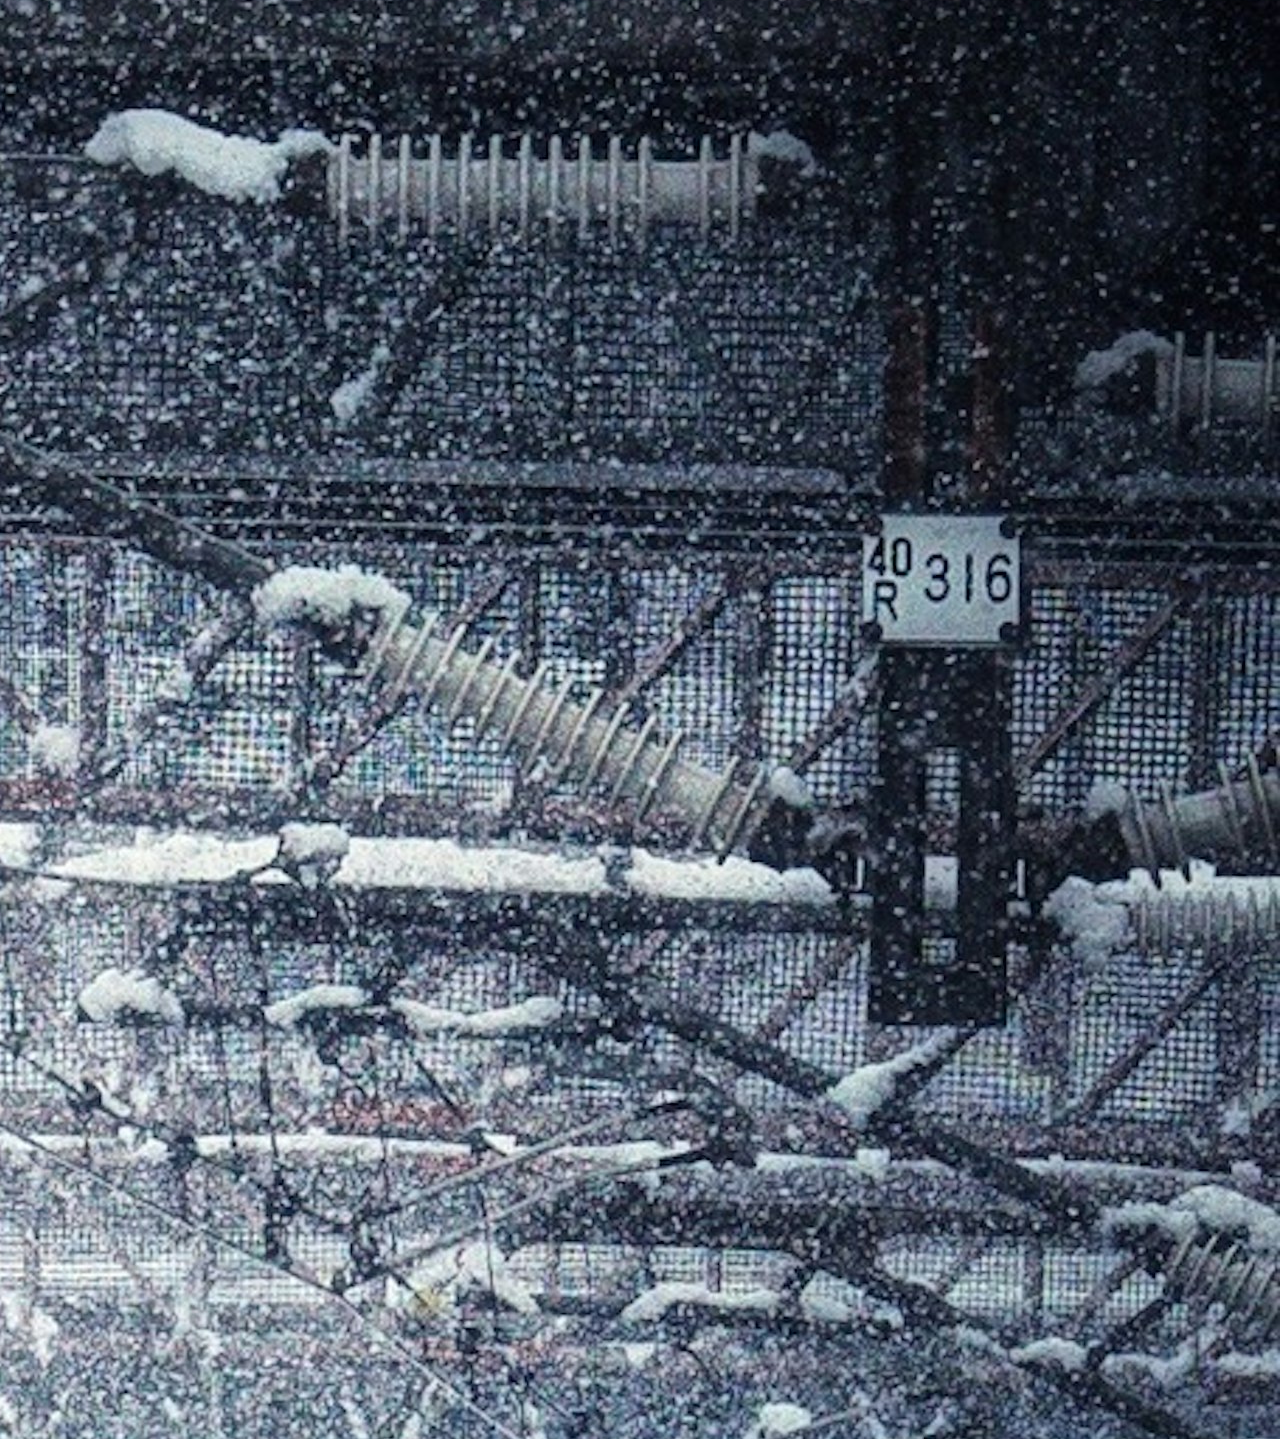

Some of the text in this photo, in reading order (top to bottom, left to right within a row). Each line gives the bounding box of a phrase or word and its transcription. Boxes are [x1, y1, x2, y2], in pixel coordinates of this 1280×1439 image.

[868, 536, 912, 577] 40
[925, 552, 1013, 604] 316
[872, 580, 899, 621] R
